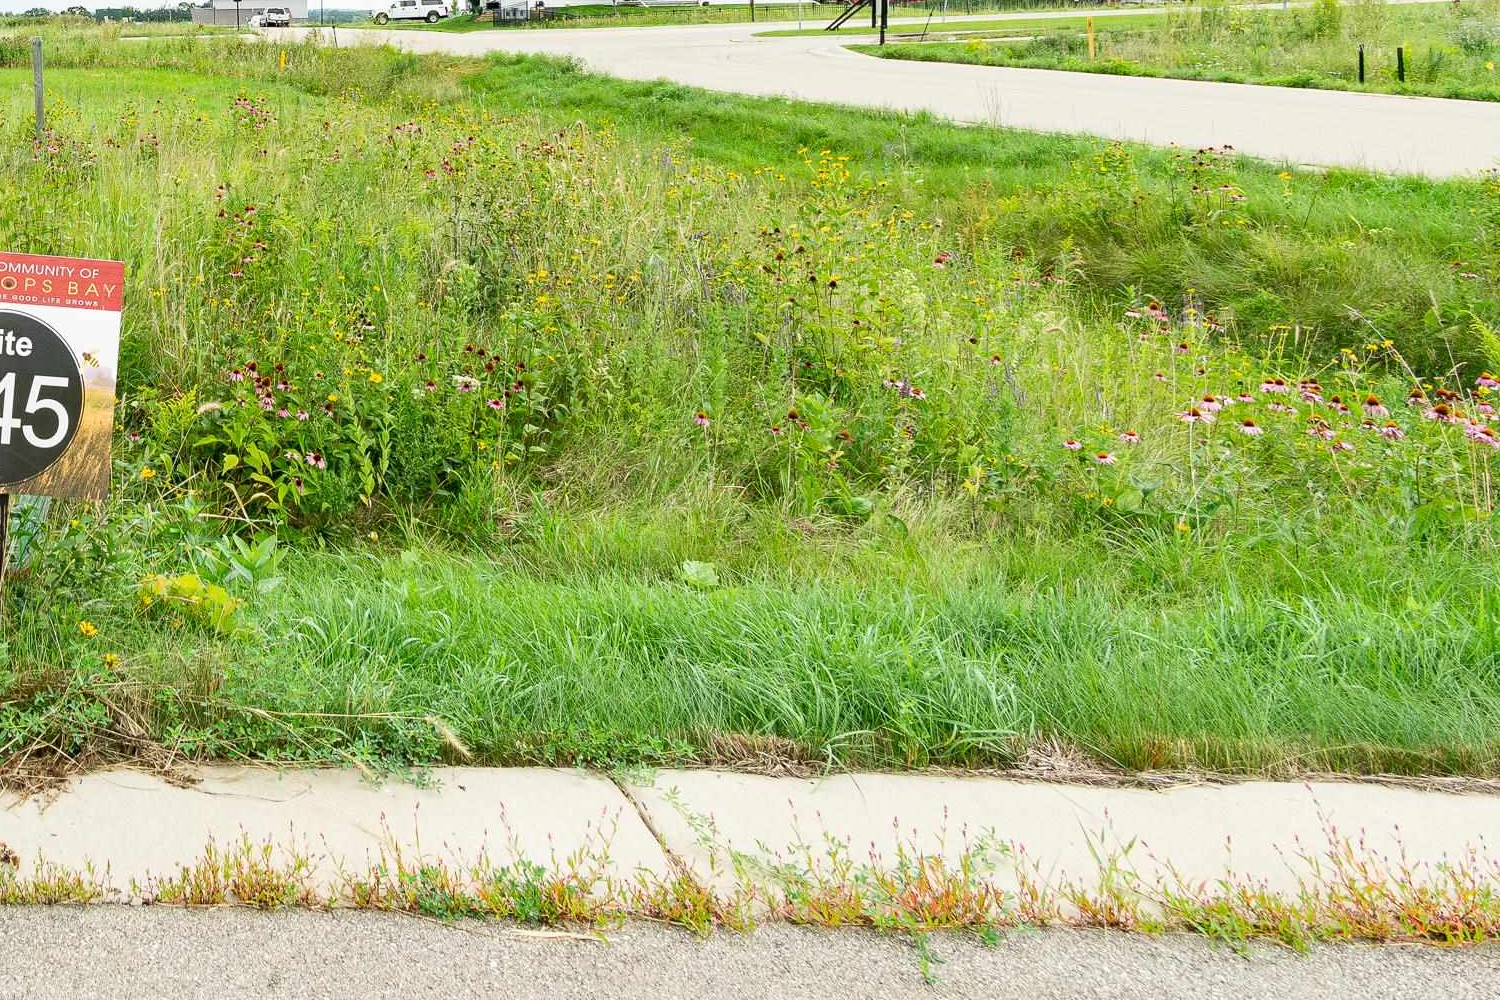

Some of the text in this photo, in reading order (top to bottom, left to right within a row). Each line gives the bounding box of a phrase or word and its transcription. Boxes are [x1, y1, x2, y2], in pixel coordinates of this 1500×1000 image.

[80, 267, 100, 279] OF
[68, 282, 117, 298] BAY
[12, 295, 38, 303] GOOD
